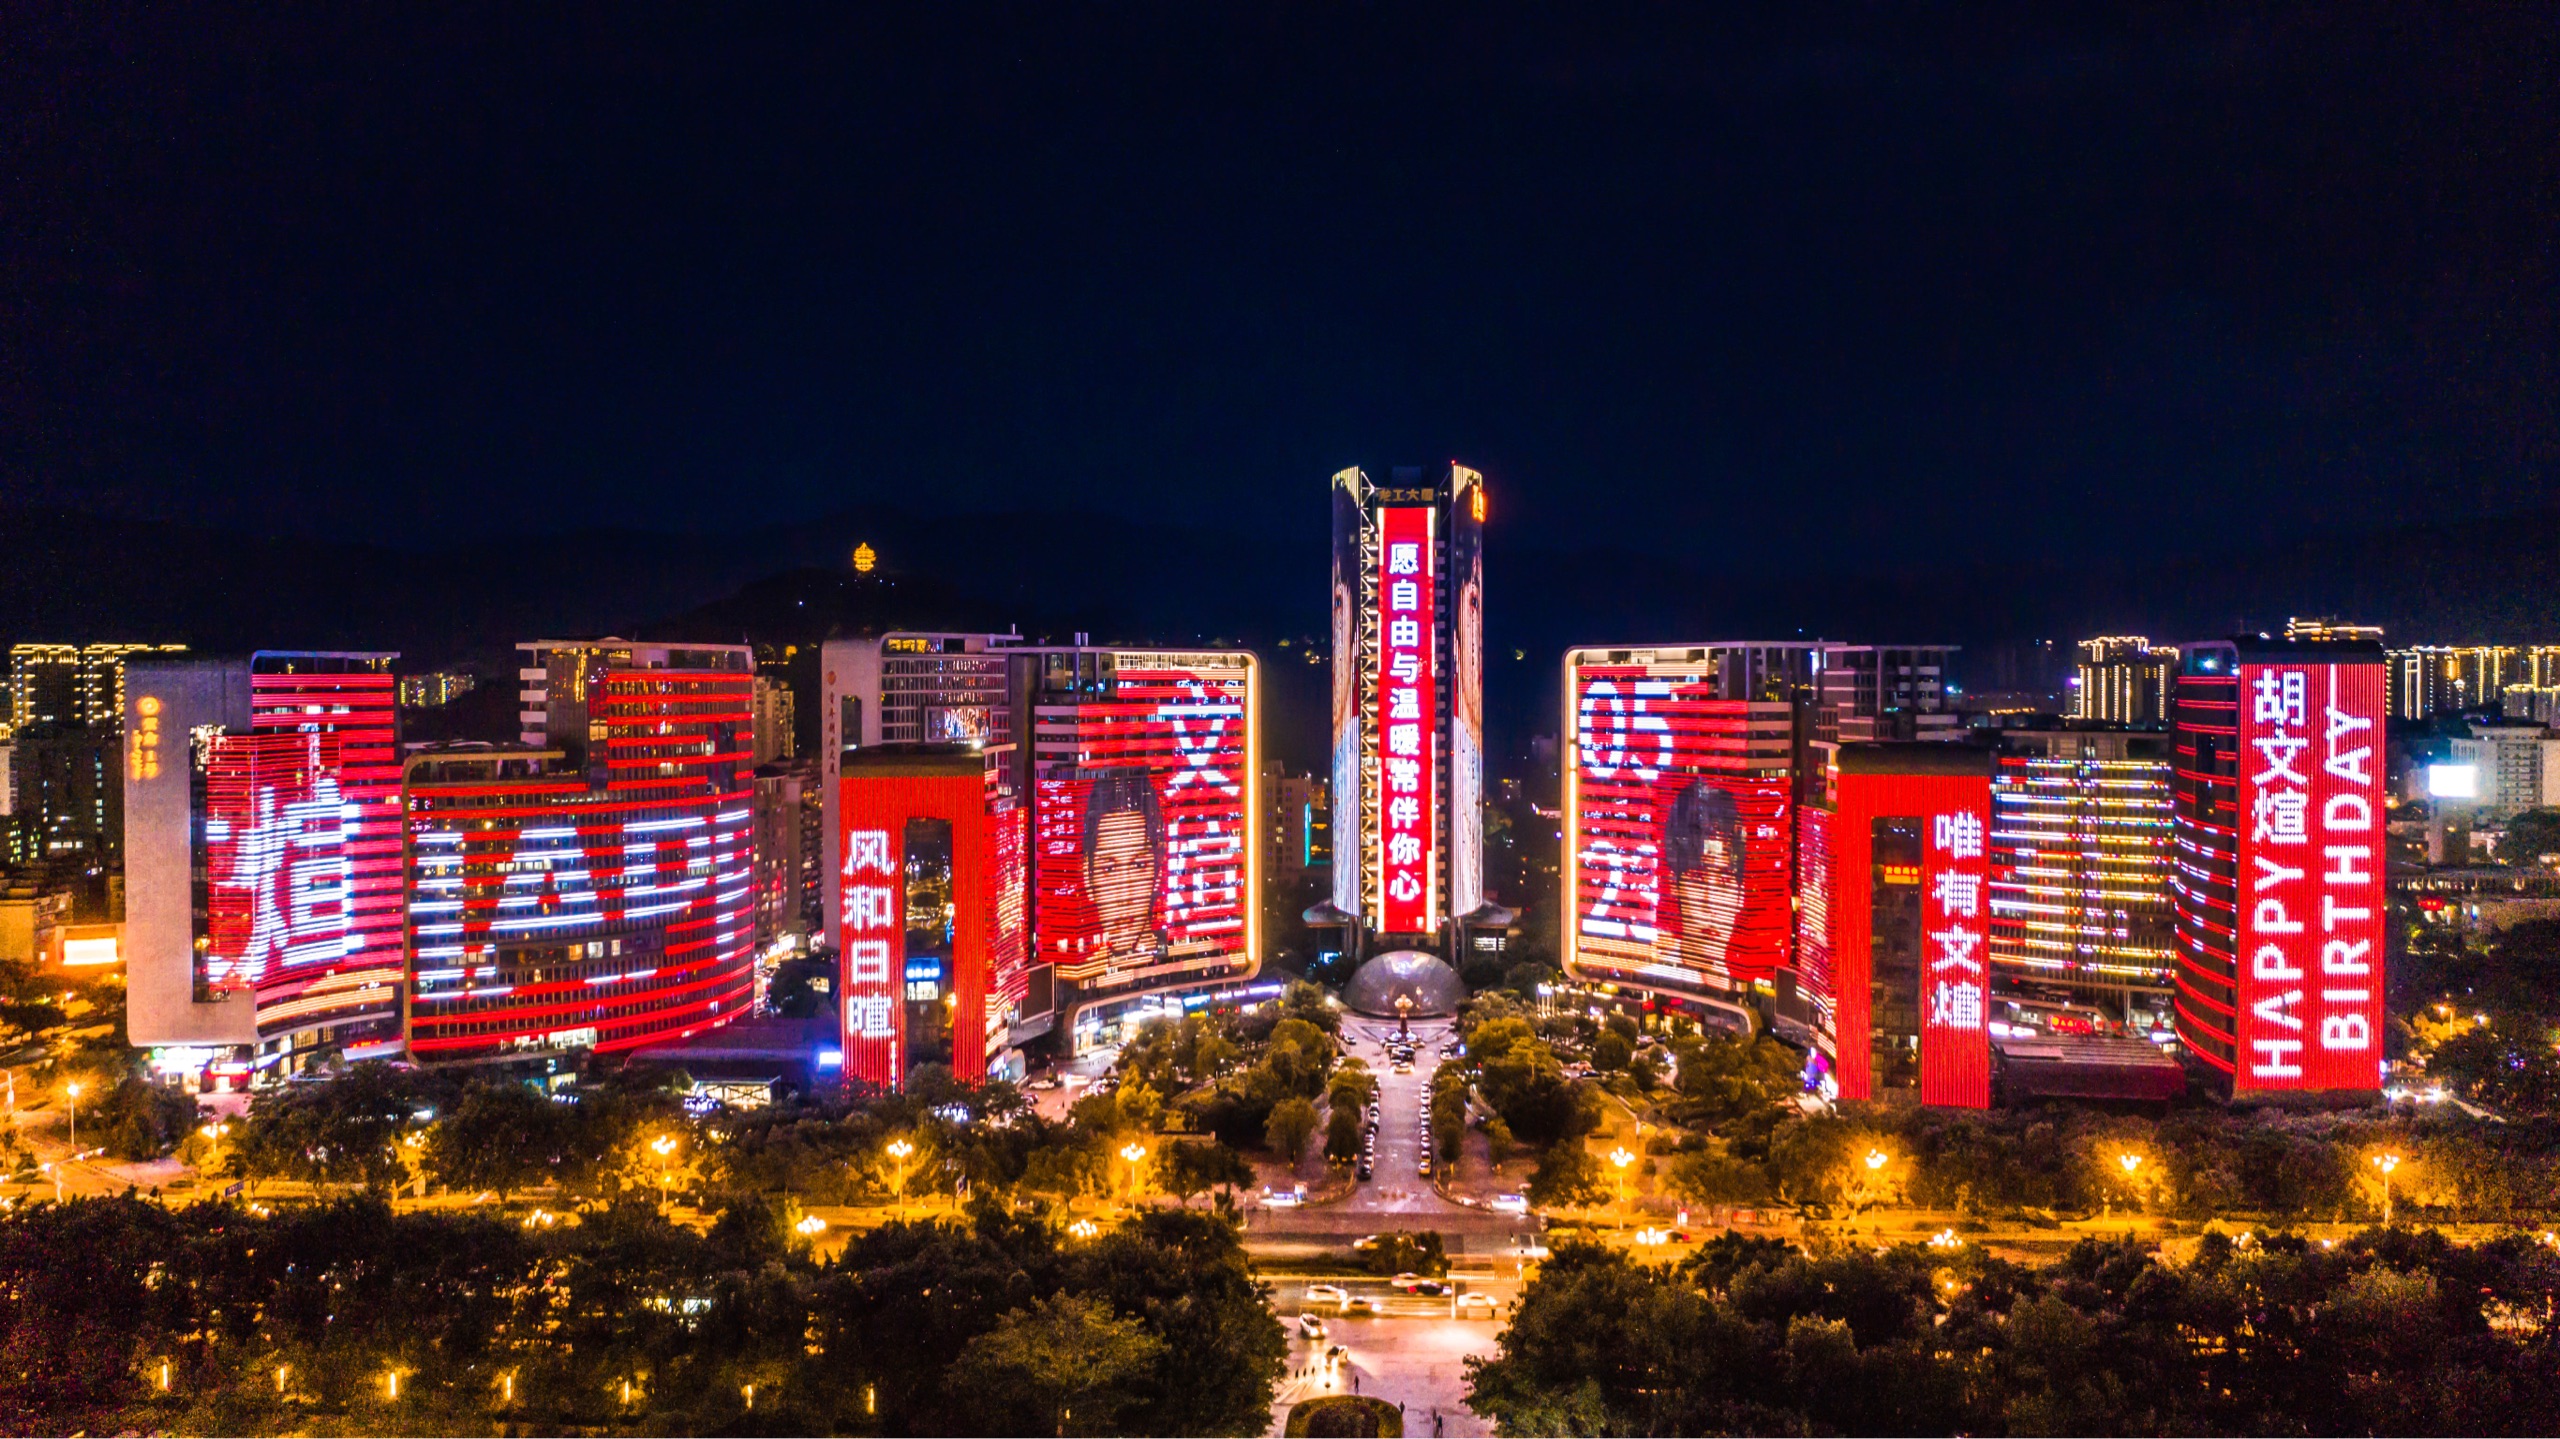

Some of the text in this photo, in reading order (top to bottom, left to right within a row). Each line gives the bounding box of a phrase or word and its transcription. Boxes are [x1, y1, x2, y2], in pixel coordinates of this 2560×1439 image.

[1389, 542, 1420, 902] 愿自由与温暖常伴你心
[1579, 681, 1673, 780] 05
[2251, 667, 2308, 844] 胡文煊
[1930, 810, 1983, 1030] 唯有文煊
[2252, 855, 2305, 1078] HAPPY
[2322, 705, 2374, 1051] BIRTHDAY
